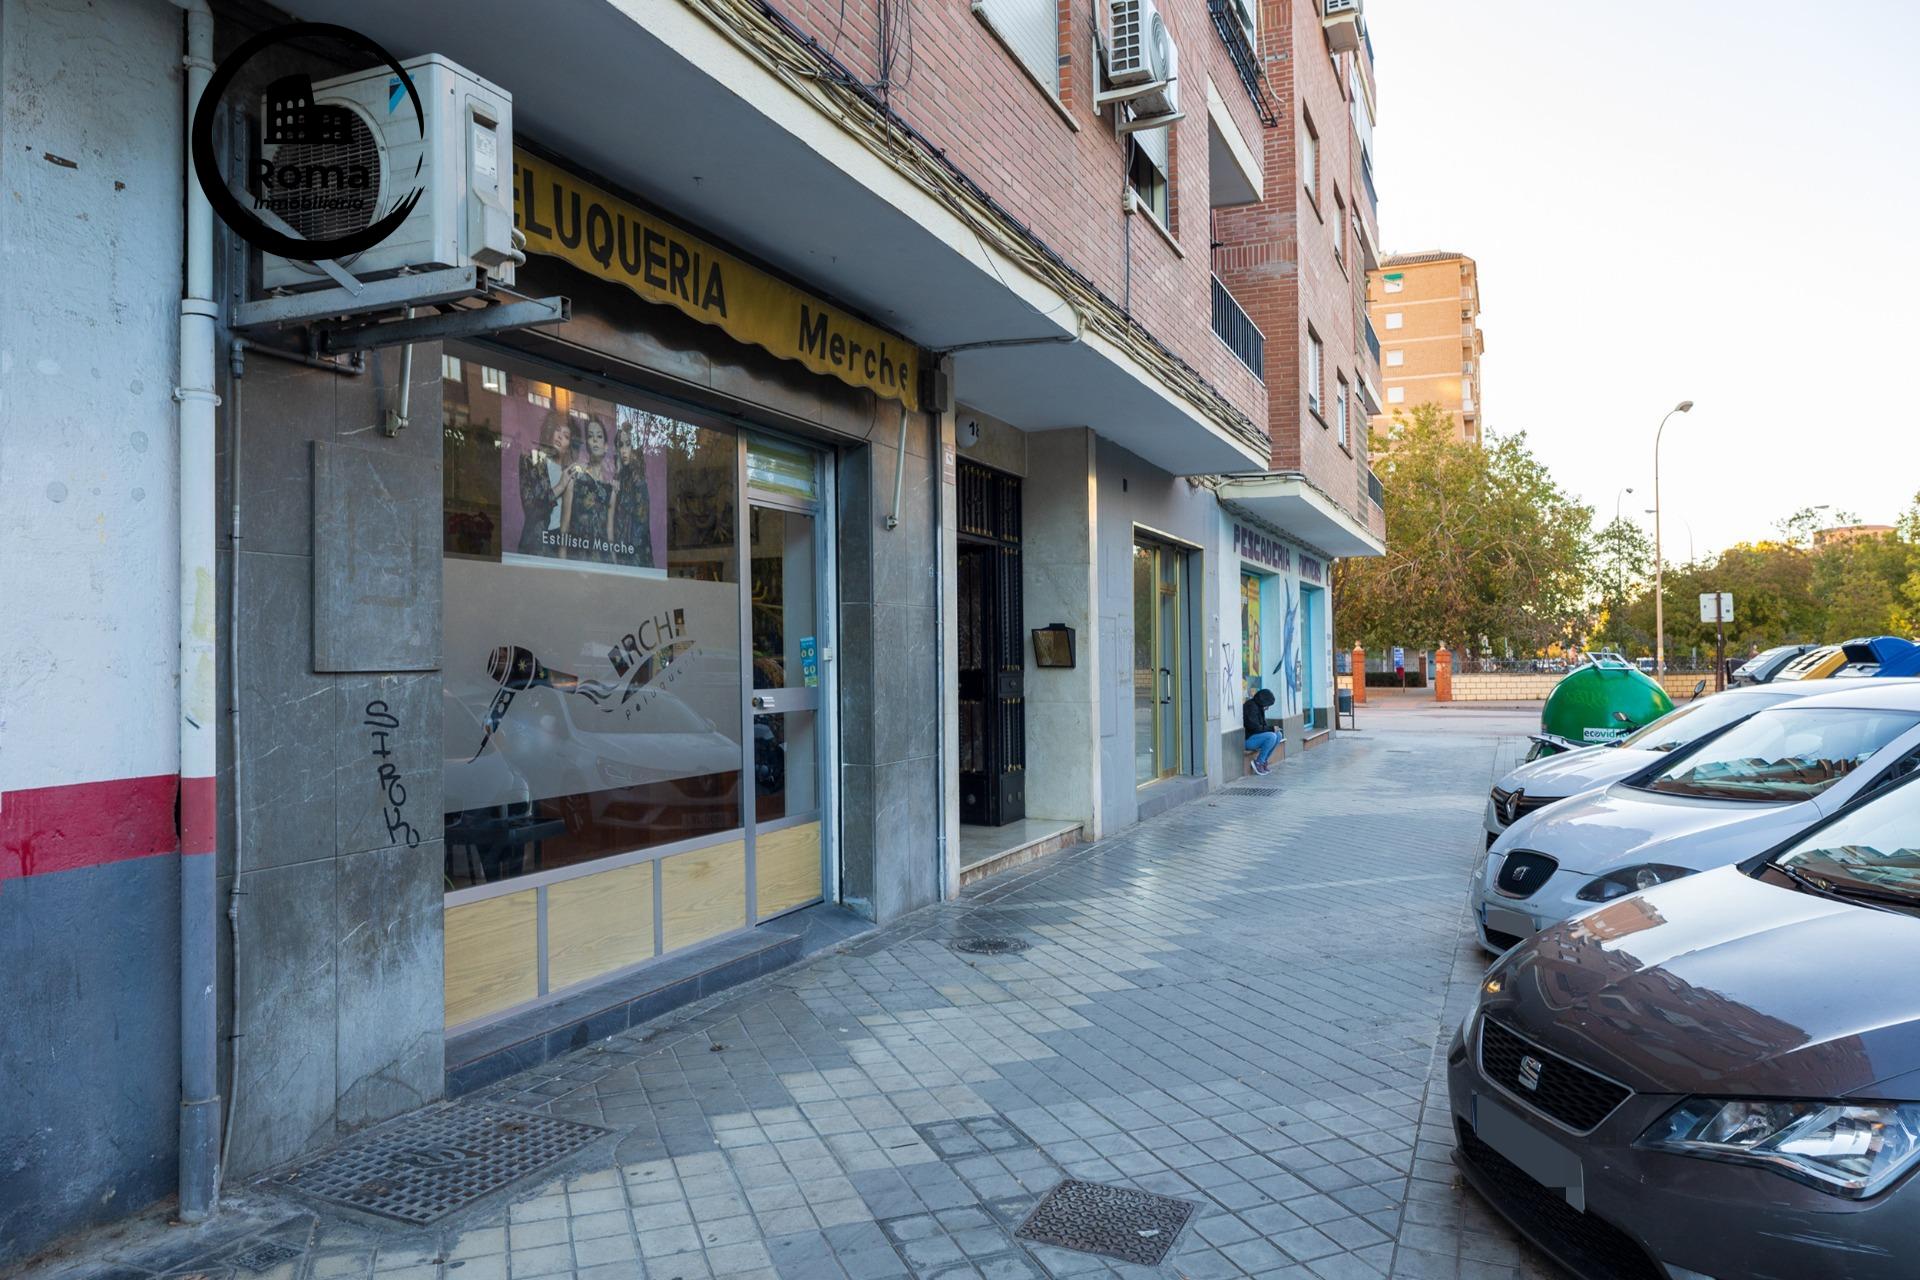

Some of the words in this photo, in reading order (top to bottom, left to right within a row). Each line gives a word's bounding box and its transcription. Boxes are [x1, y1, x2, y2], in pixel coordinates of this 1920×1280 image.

[799, 304, 908, 392] Merche
[542, 531, 590, 549] Estilista
[593, 538, 635, 554] Merche
